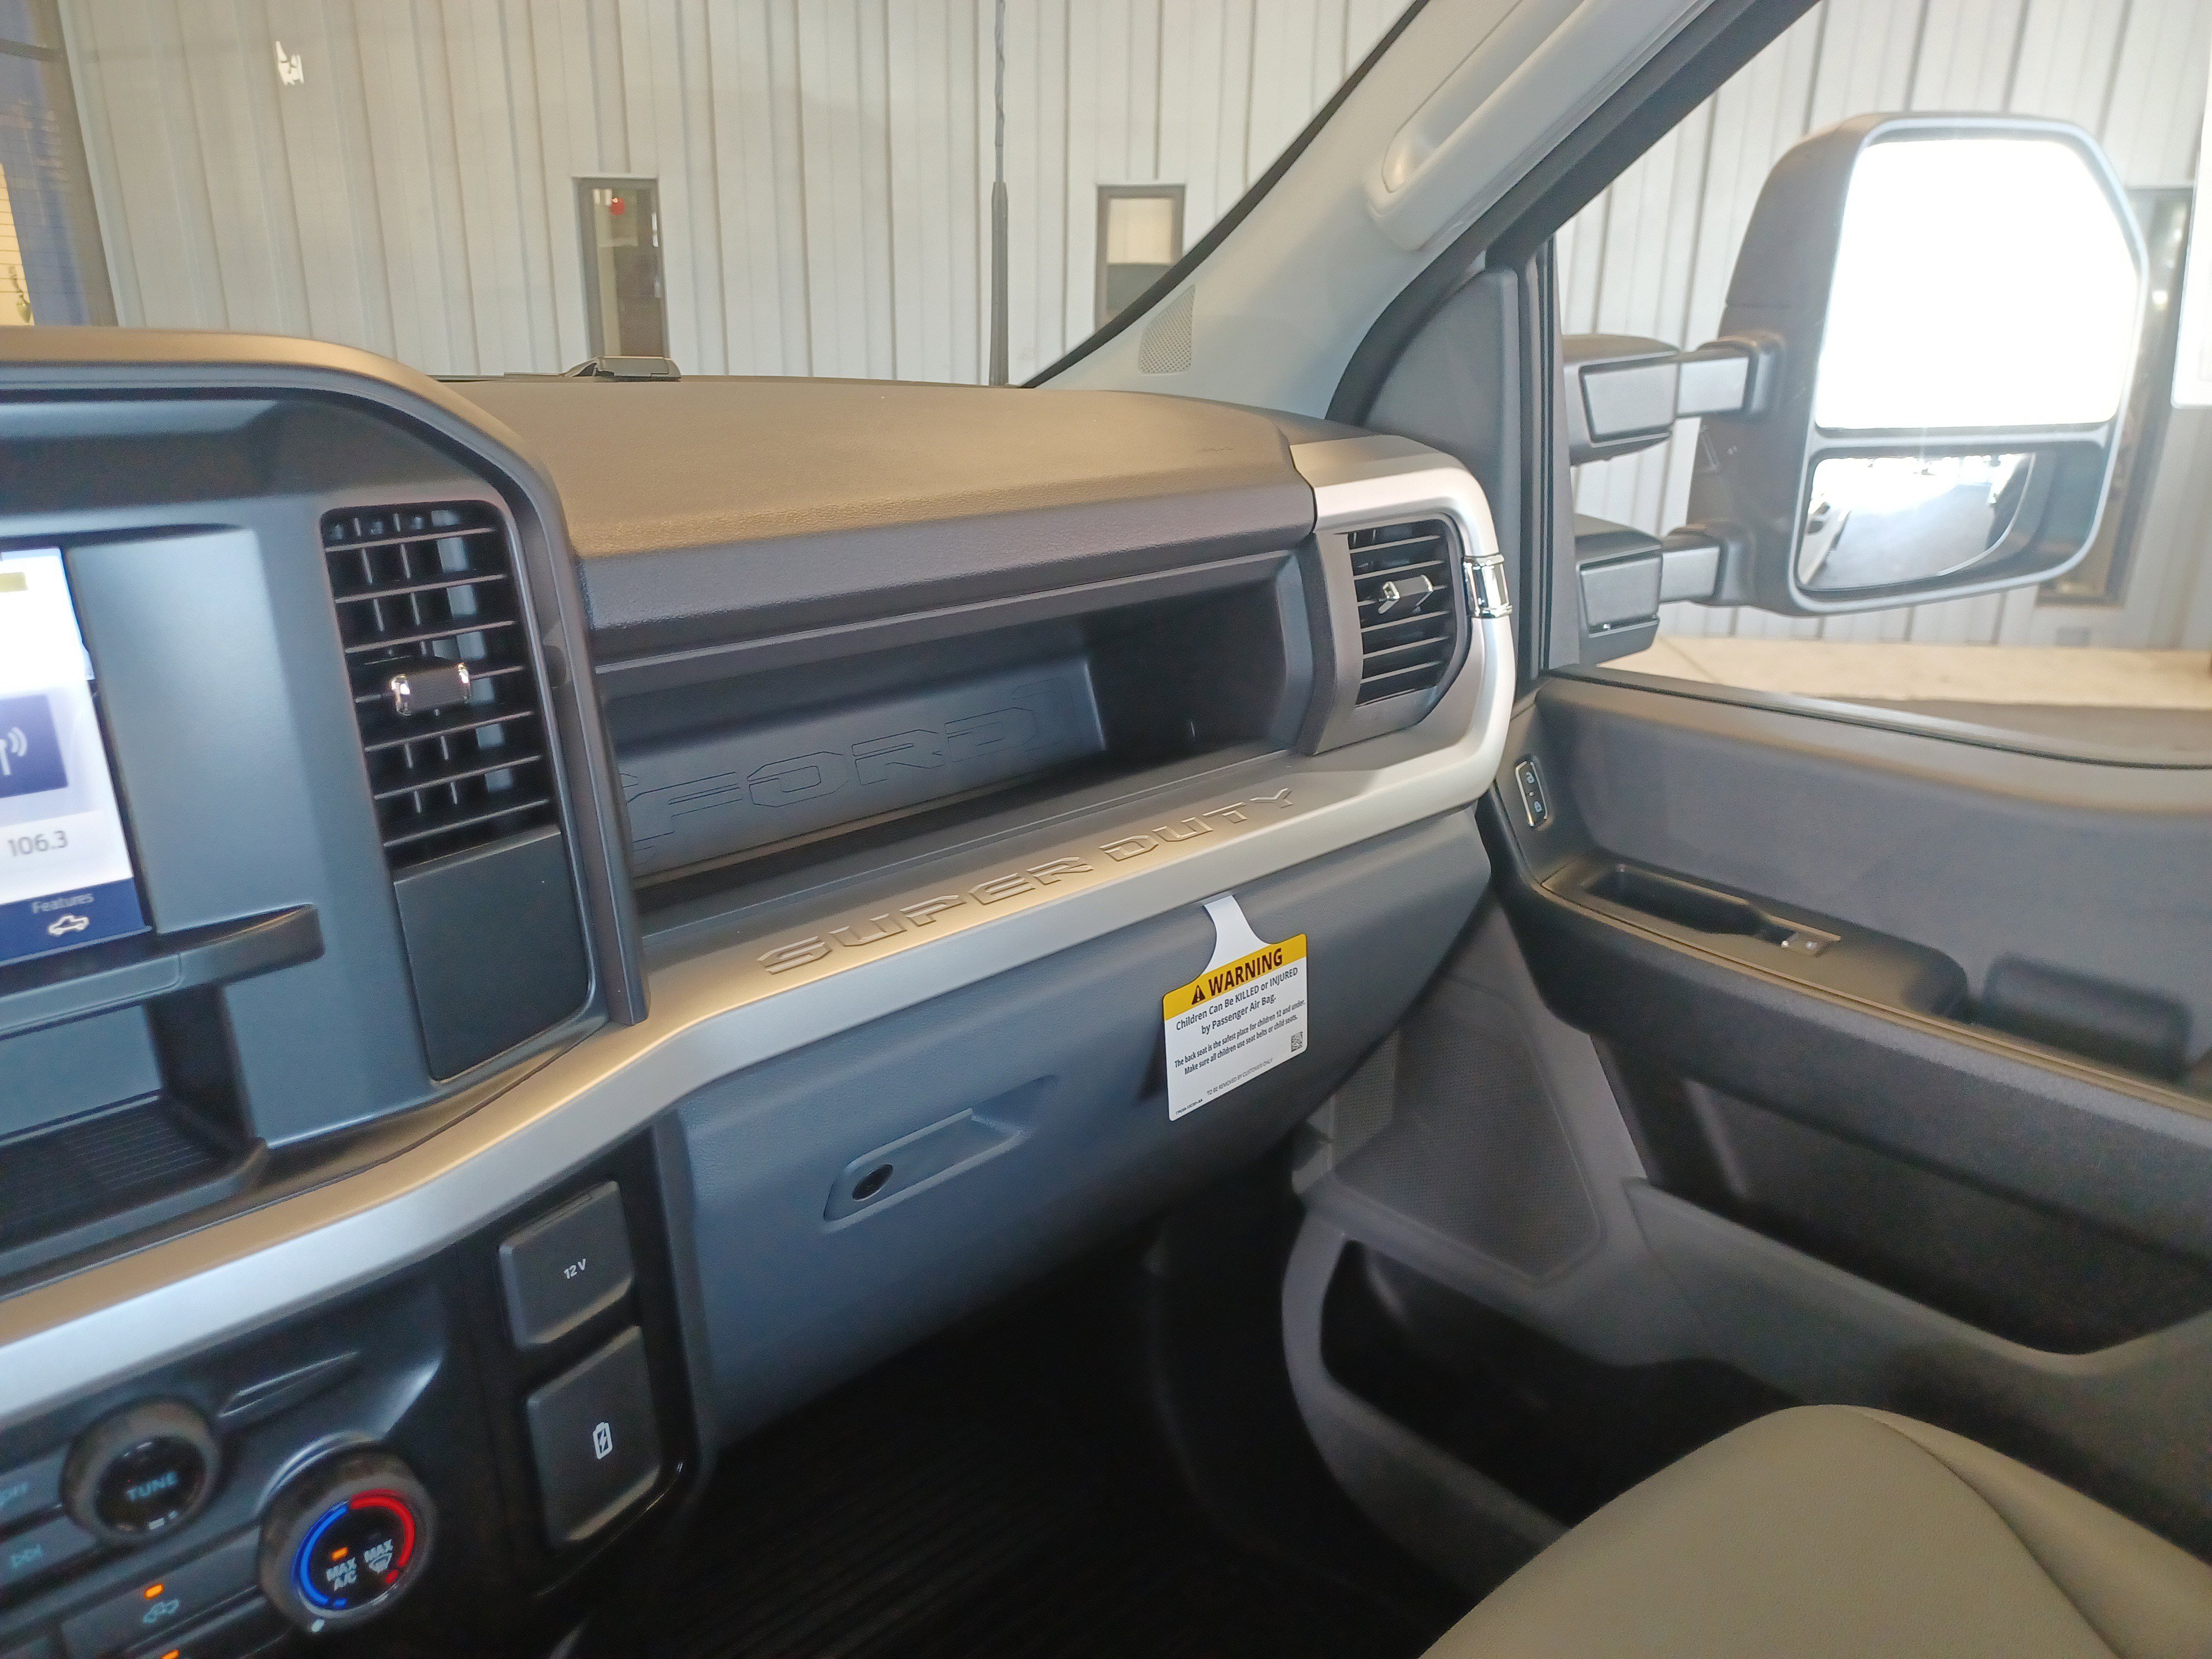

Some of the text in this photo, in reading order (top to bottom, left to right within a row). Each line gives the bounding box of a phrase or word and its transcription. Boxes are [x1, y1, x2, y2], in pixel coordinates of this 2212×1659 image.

[627, 707, 1037, 842] FORD
[8, 830, 68, 857] 106.3
[757, 787, 1293, 975] SUPER DUTY
[1208, 947, 1283, 997] WARNING
[1176, 967, 1298, 1030] Children Can Be KILLED or INJURED
[1201, 994, 1276, 1035] by Passenger Air Bag.
[1175, 1059, 1184, 1068] The
[1185, 1052, 1196, 1063] back
[1197, 1047, 1207, 1057] seat
[1213, 1040, 1221, 1048] the
[1222, 1033, 1236, 1045] safest
[1237, 1027, 1249, 1039] place
[1258, 1014, 1275, 1027] children
[1282, 1005, 1291, 1015] and
[1185, 1063, 1198, 1075] Make
[1199, 1058, 1209, 1067] sure
[1217, 1045, 1236, 1058] children
[1237, 1040, 1245, 1048] use
[1246, 1035, 1255, 1044] seat
[1256, 1029, 1267, 1039] belts
[1274, 1019, 1284, 1030] child
[1219, 1077, 1237, 1090] REMOVED
[564, 1258, 586, 1279] 12 V
[127, 1471, 178, 1501] TUNE
[363, 1538, 394, 1563] MAX
[326, 1557, 357, 1582] MAX
[334, 1569, 357, 1592] A/C
